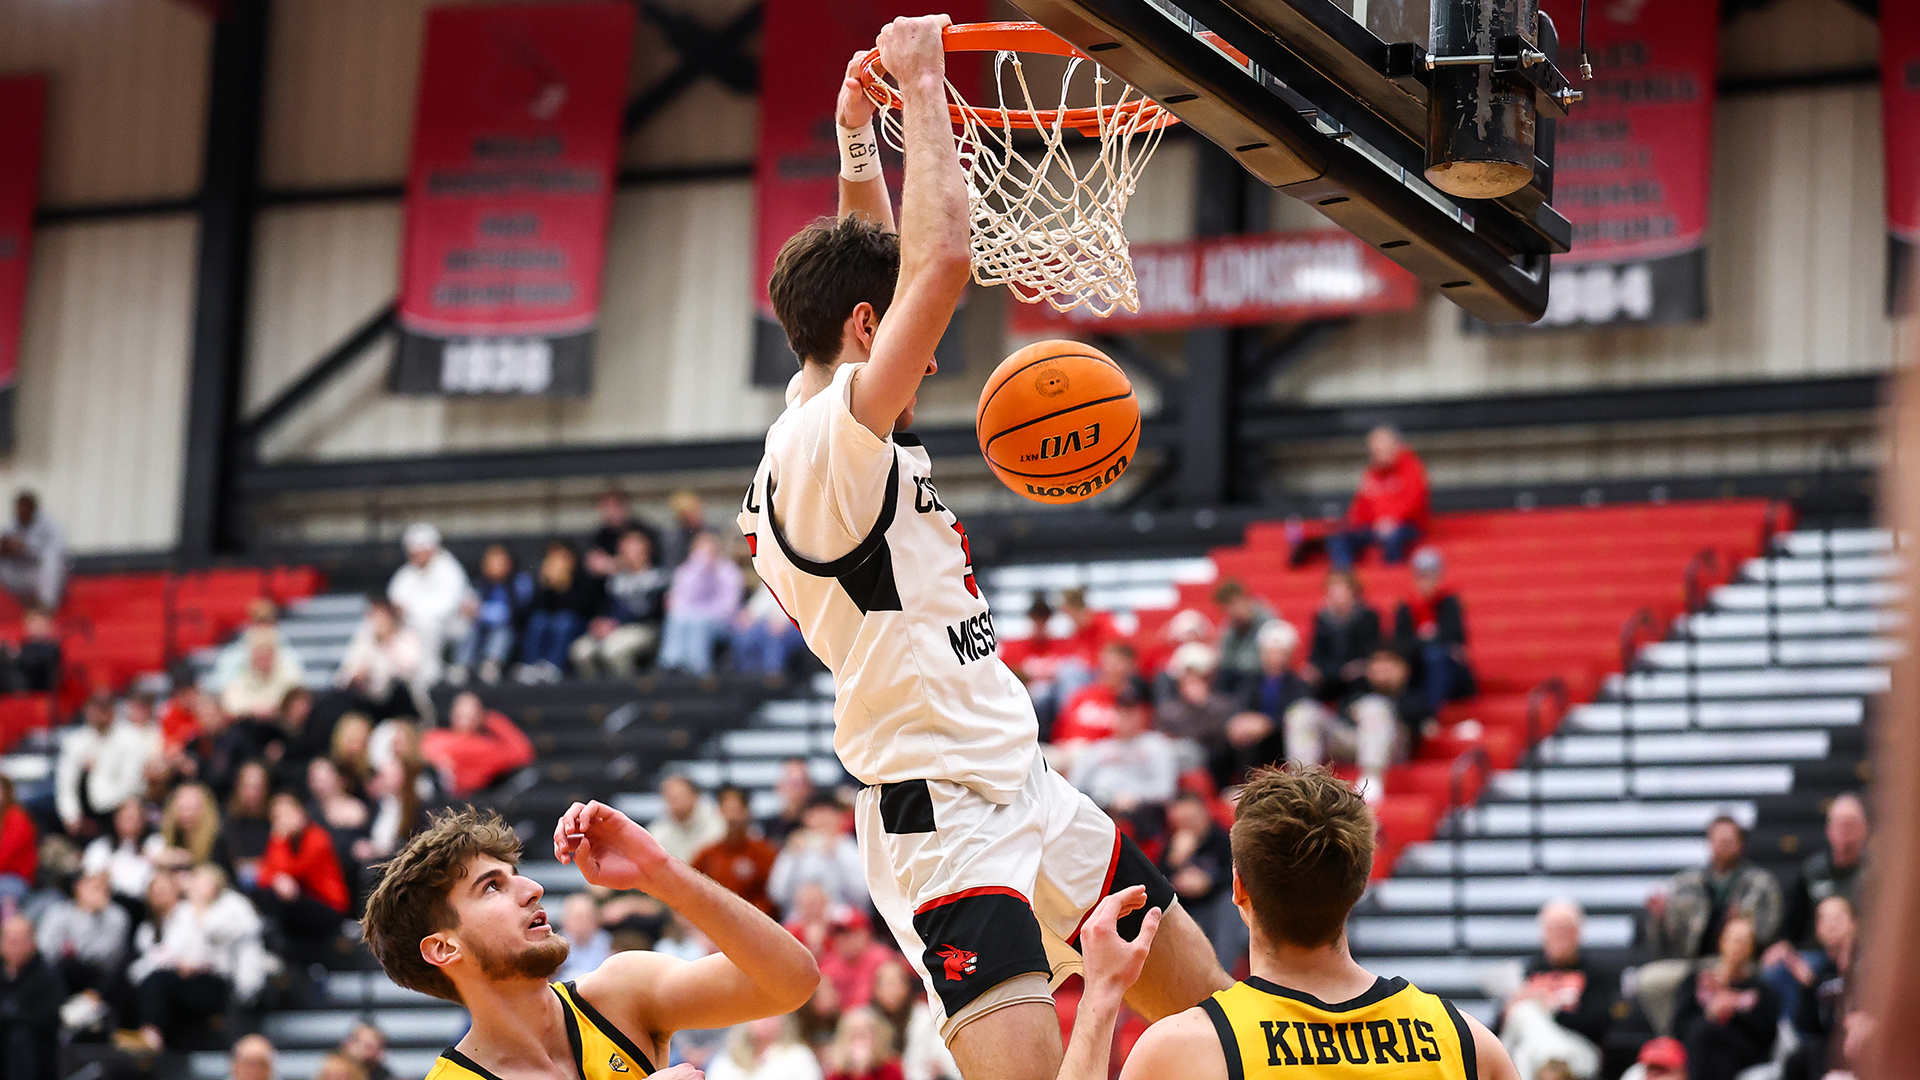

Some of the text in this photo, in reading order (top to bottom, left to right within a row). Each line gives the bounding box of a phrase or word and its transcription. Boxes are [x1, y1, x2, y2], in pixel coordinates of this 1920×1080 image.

[1019, 422, 1100, 462] EVO NXT
[1025, 455, 1128, 497] Wilson
[1260, 1018, 1442, 1067] KIBURIS
